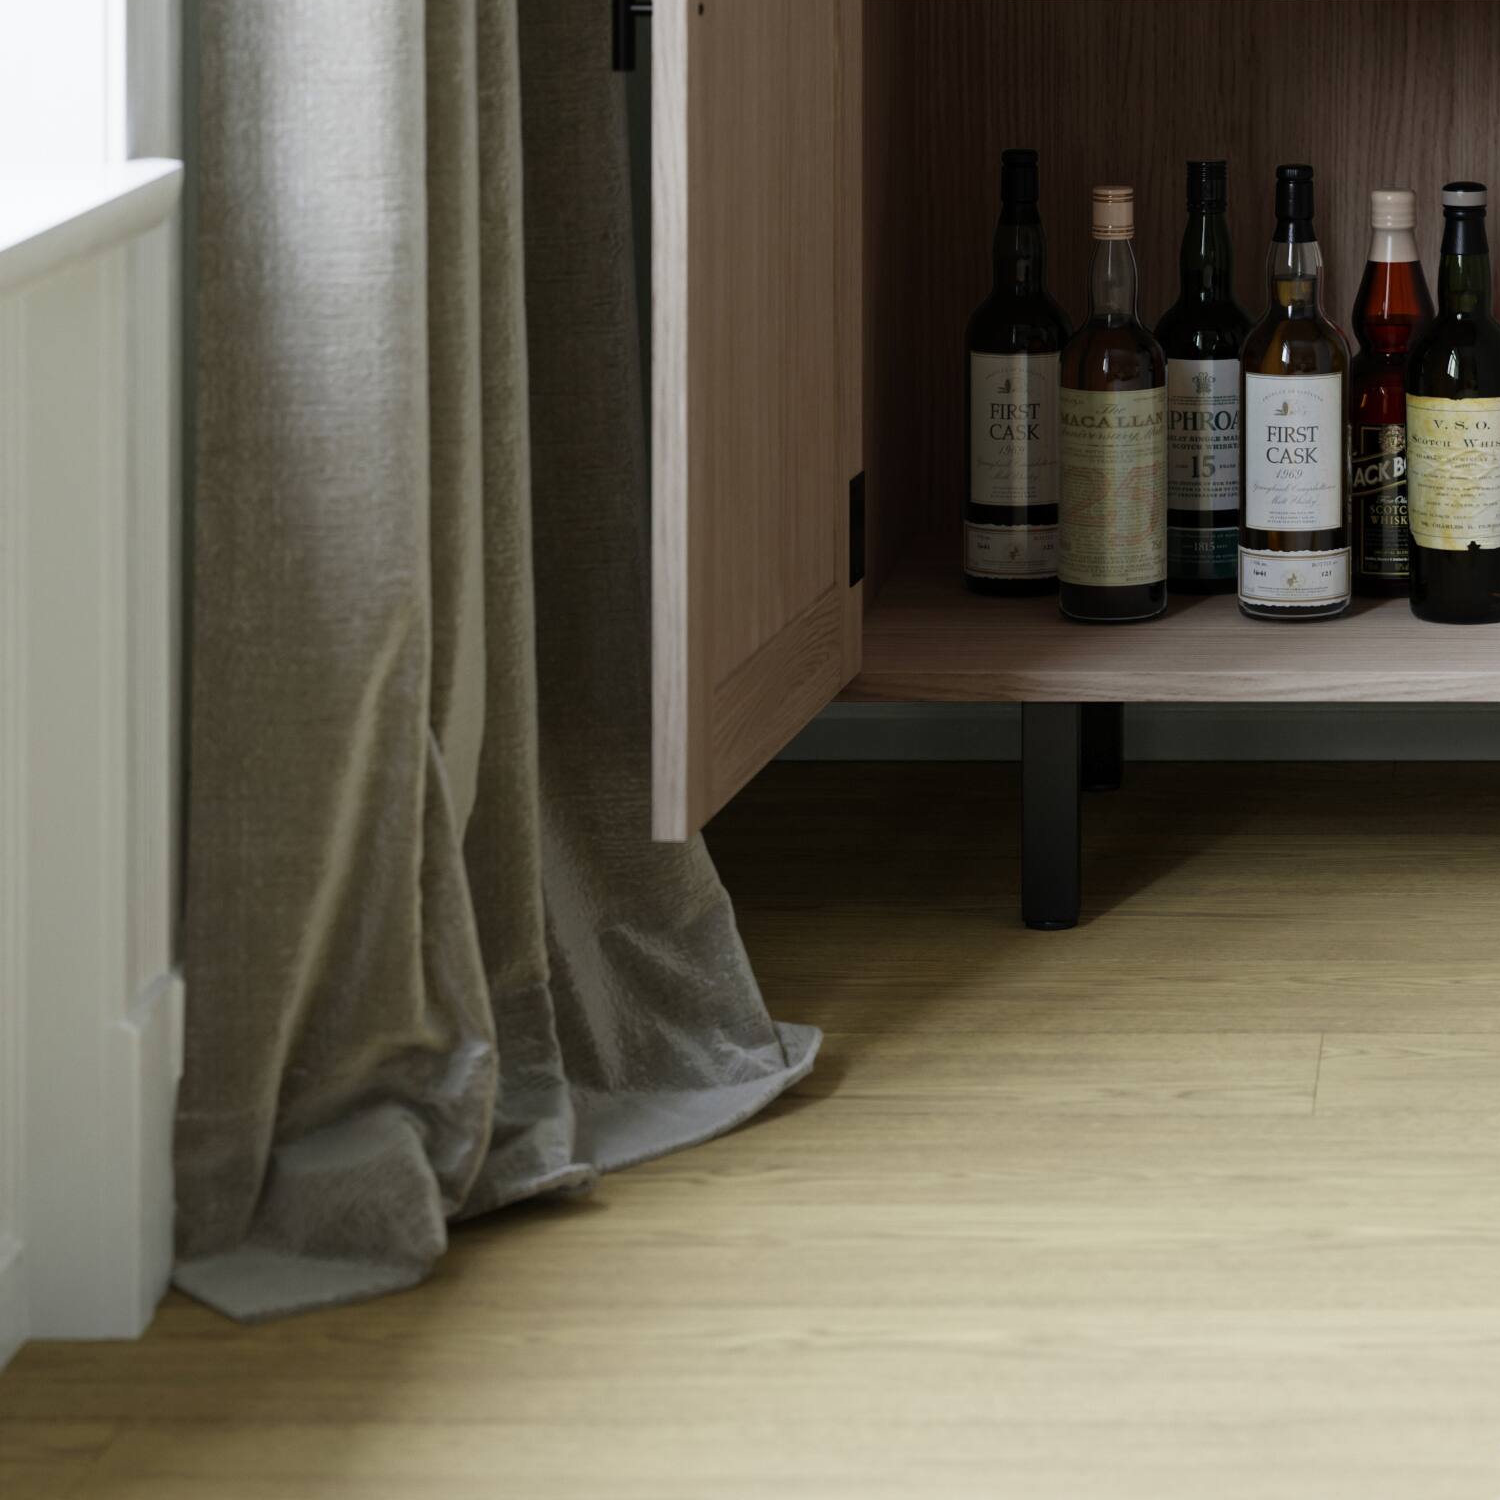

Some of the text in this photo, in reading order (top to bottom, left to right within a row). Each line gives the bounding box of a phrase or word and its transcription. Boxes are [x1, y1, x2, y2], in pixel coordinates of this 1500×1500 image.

[990, 403, 1041, 420] FIRST
[989, 423, 1041, 441] CASK
[1267, 426, 1319, 443] FIRST
[1266, 446, 1319, 464] CASK
[1192, 455, 1217, 479] 15
[1353, 461, 1392, 487] ACK
[1369, 504, 1408, 516] SCOTC
[1369, 515, 1409, 526] WHISK
